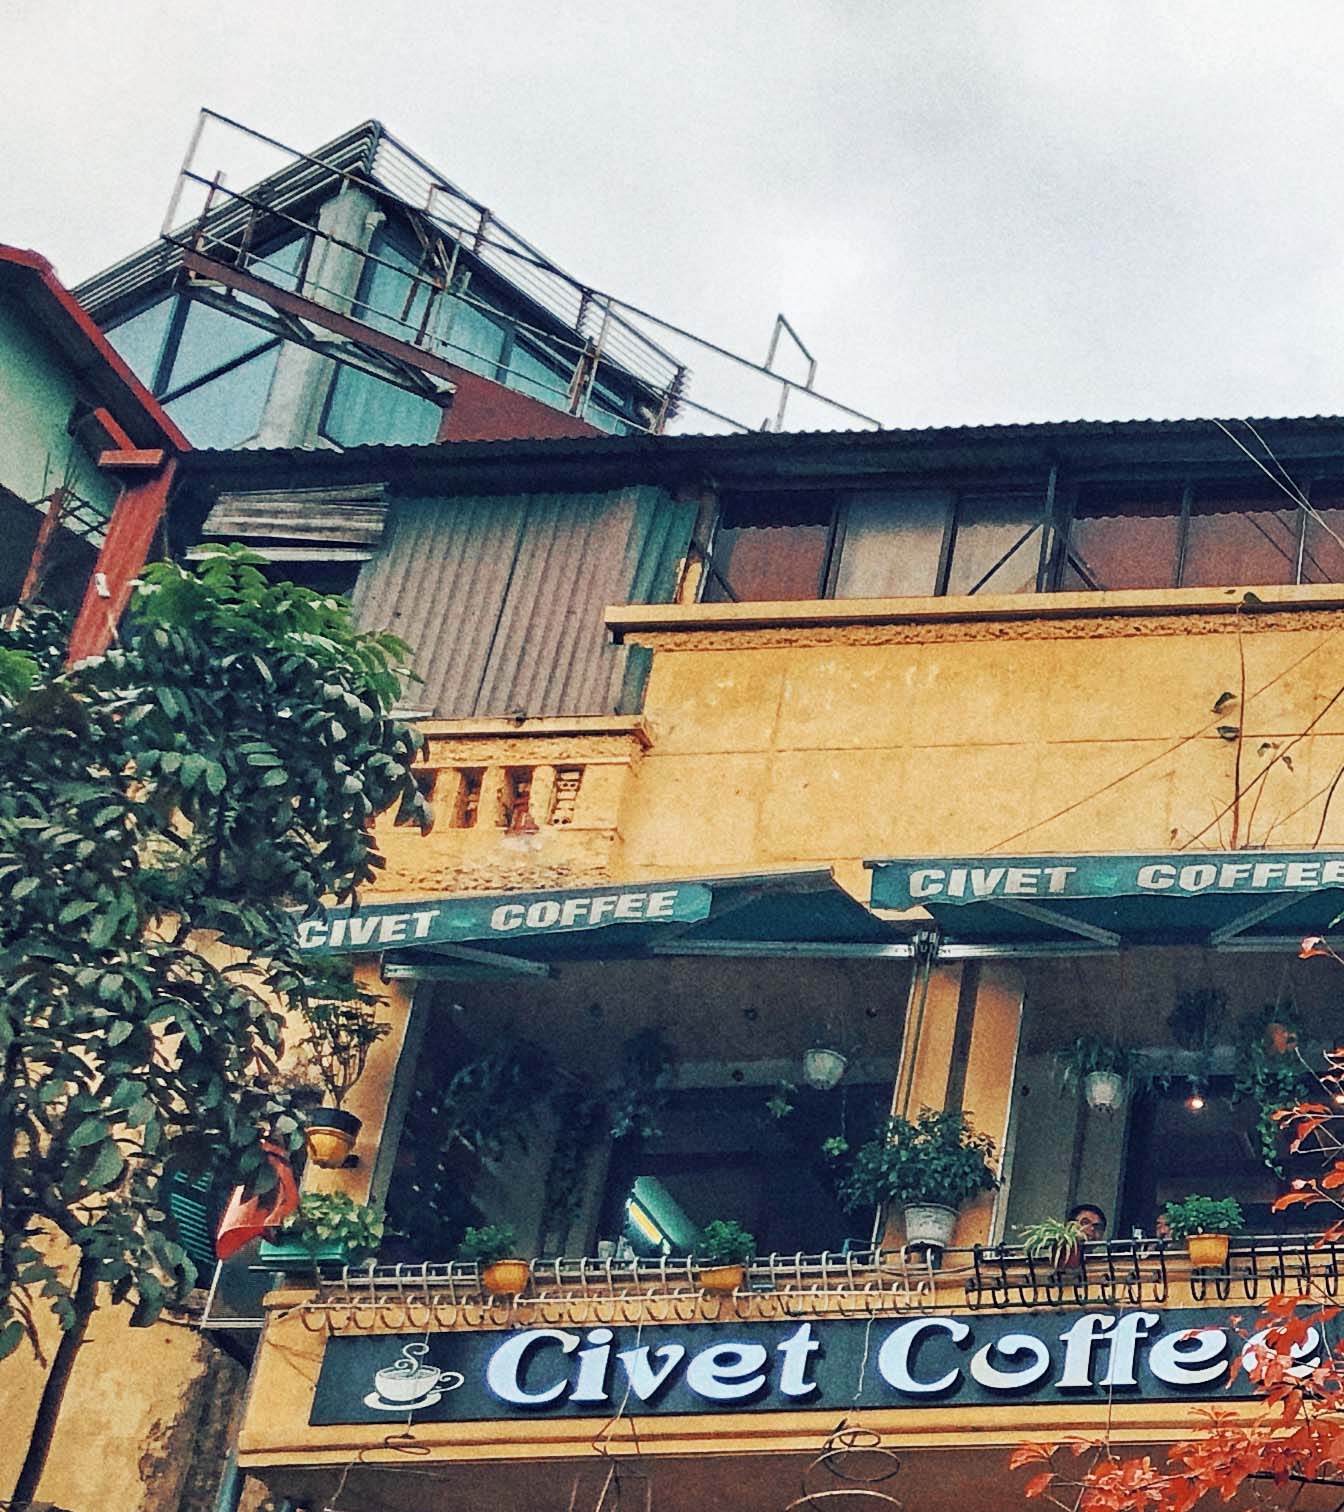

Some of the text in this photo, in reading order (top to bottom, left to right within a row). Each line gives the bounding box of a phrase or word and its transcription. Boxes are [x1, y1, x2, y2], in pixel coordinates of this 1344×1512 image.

[909, 866, 1077, 898] CIVET
[297, 889, 679, 949] CIVET COFFEE
[487, 1322, 819, 1403] Civet
